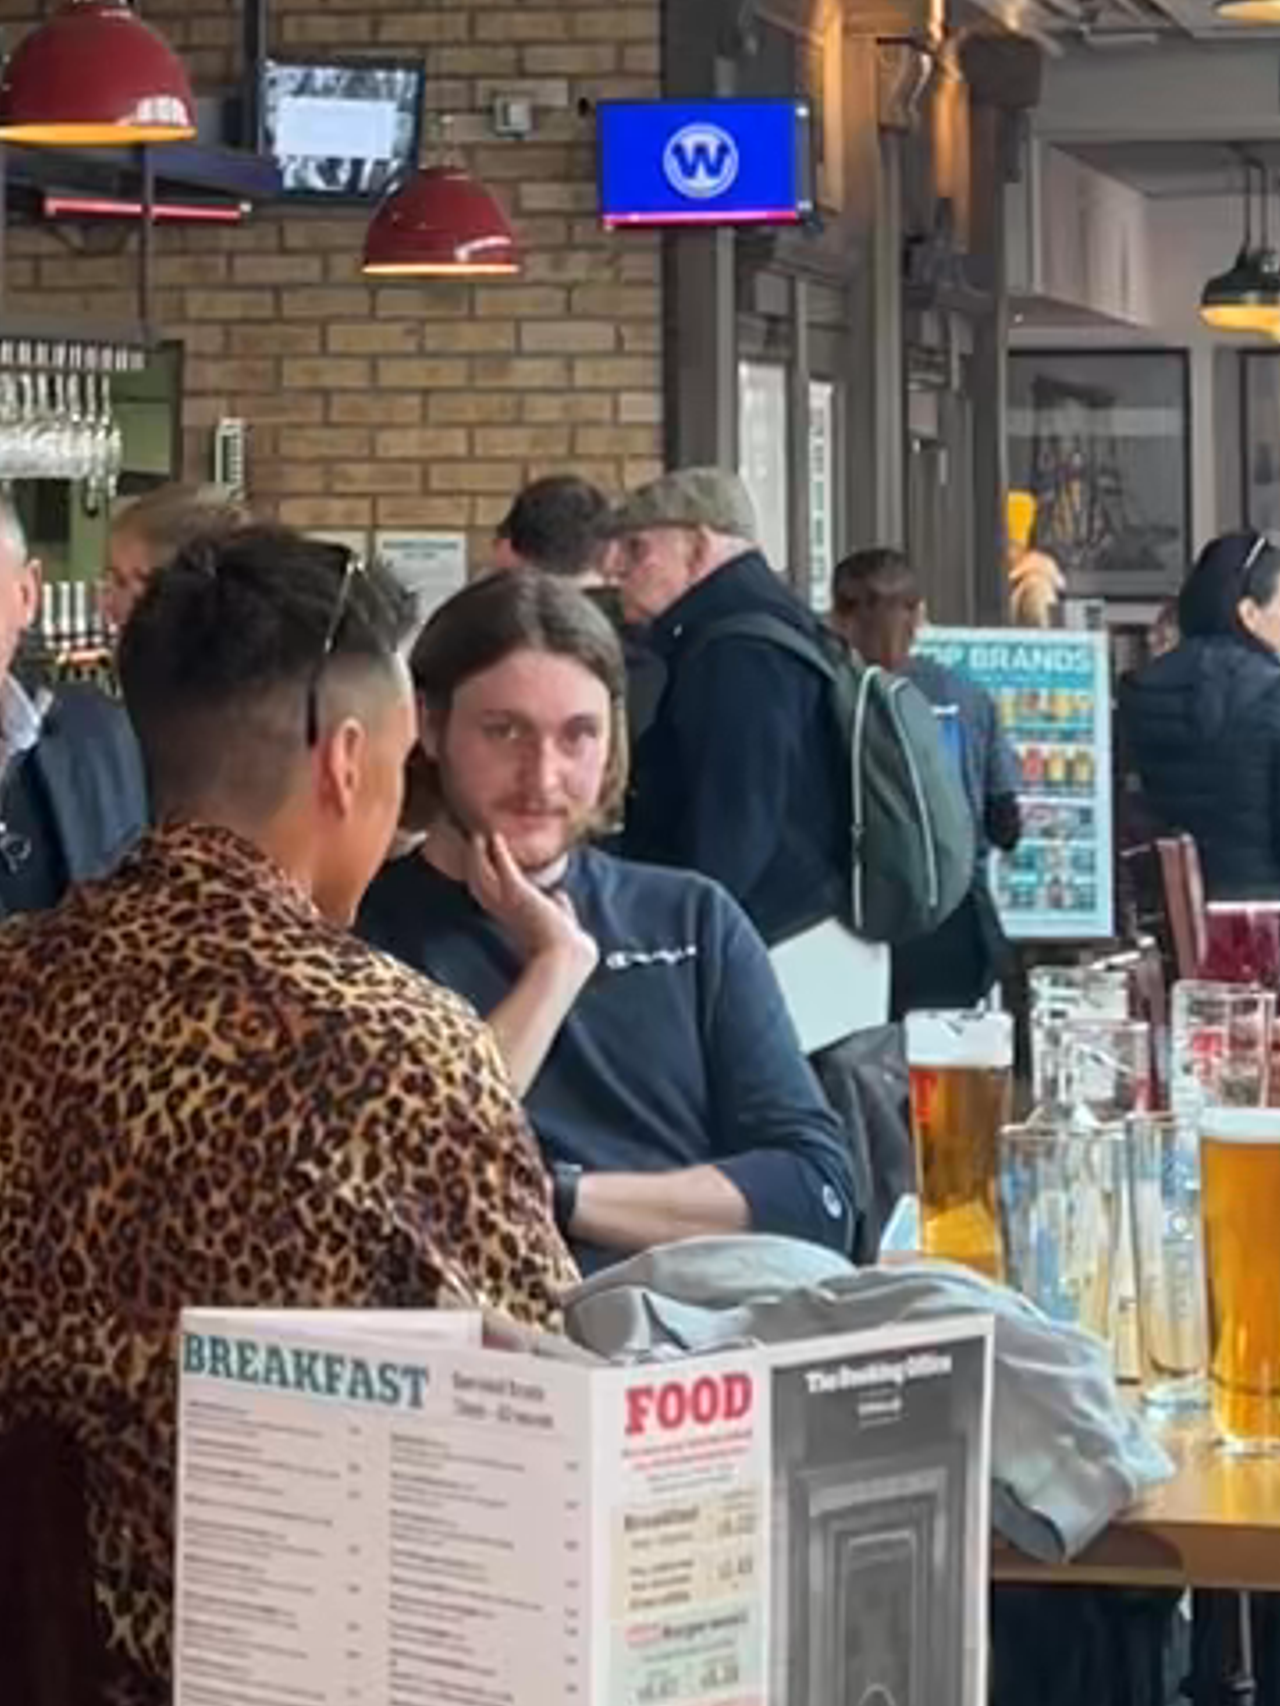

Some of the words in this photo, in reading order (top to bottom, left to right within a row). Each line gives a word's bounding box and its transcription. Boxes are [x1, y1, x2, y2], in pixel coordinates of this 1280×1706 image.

[969, 644, 1088, 673] BRANDS
[182, 1332, 430, 1409] BREAKFAST
[624, 1371, 753, 1436] FOOD
